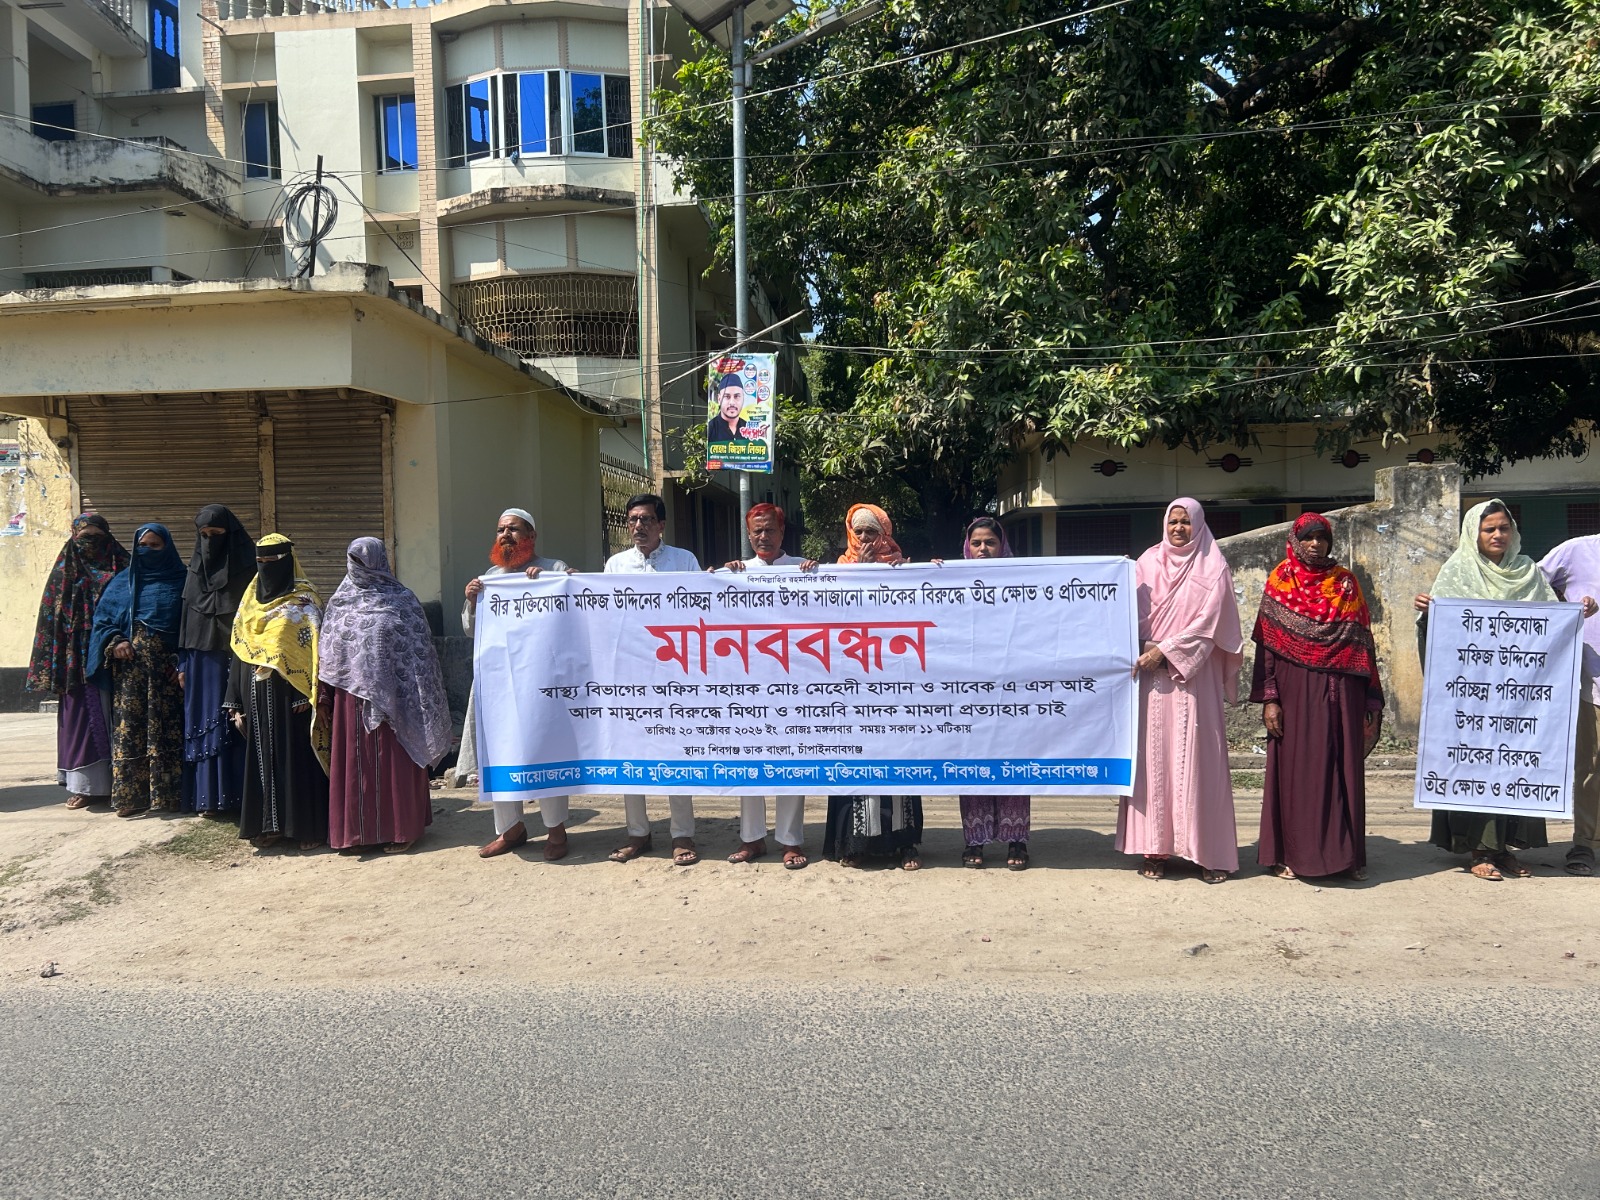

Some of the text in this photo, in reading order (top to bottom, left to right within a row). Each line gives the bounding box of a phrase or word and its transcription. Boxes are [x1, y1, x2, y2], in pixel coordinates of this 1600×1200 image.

[788, 574, 817, 583] রহমানির
[819, 574, 837, 583] রহিম
[490, 578, 1118, 619] বীর মুক্তিযোদ্ধা মফিজ উদ্দিনের পরিচ্ছন্ন পরিবারের উপর সাজানো নাটকের বিরুদ্ধে তীব্র ক্ষোভ ও প্রতিবাদে
[1461, 609, 1549, 638] বীর মুক্তিযোদ্ধা
[644, 617, 937, 675] মানববন্ধন
[1457, 643, 1548, 668] মফিজ উদ্দিনের
[539, 676, 1097, 700] স্বাস্থ্য বিভাগের অফিস সহায়ক মোঃ মেহেদী হাসান ও সাবেক এ এস আই
[1445, 675, 1553, 702] পরিচ্ছন্ন পরিবারের
[569, 700, 1067, 722] আল মামুনের বিরুদ্ধে মিথ্যা ও গায়েবি মাদক মামলা প্রত্যাহার চাই
[1455, 709, 1538, 735] উপর সাজানো
[644, 722, 972, 736] তারিখঃ ২০ অক্টোবর ২০২৬ ইং রোজঃ মঙ্গলবার সময়ঃ সকাল ১১ ঘটিকায়
[683, 743, 862, 757] স্থানঃ শিবগঞ্জ ডাক বাংলা, চাঁপাইনবাবগঞ্জ
[1447, 741, 1542, 768] নাটকের বিরুদ্ধে
[509, 768, 580, 783] আয়োজনেঃ
[586, 767, 618, 778] সকল
[622, 762, 643, 778] বীর
[648, 763, 709, 781] মুক্তিযোদ্ধা
[713, 763, 758, 779] শিবগঞ্জ
[763, 764, 819, 778] উপজেলা
[824, 763, 889, 782] মুক্তিযোদ্ধা
[893, 767, 937, 781] সংসদ,
[942, 762, 995, 780] শিবগঞ্জ,
[1001, 761, 1098, 778] চাঁপাইনবাবগঞ্জ
[1423, 771, 1561, 802] তীব্র ক্ষোভ ও প্রতিবাদে
